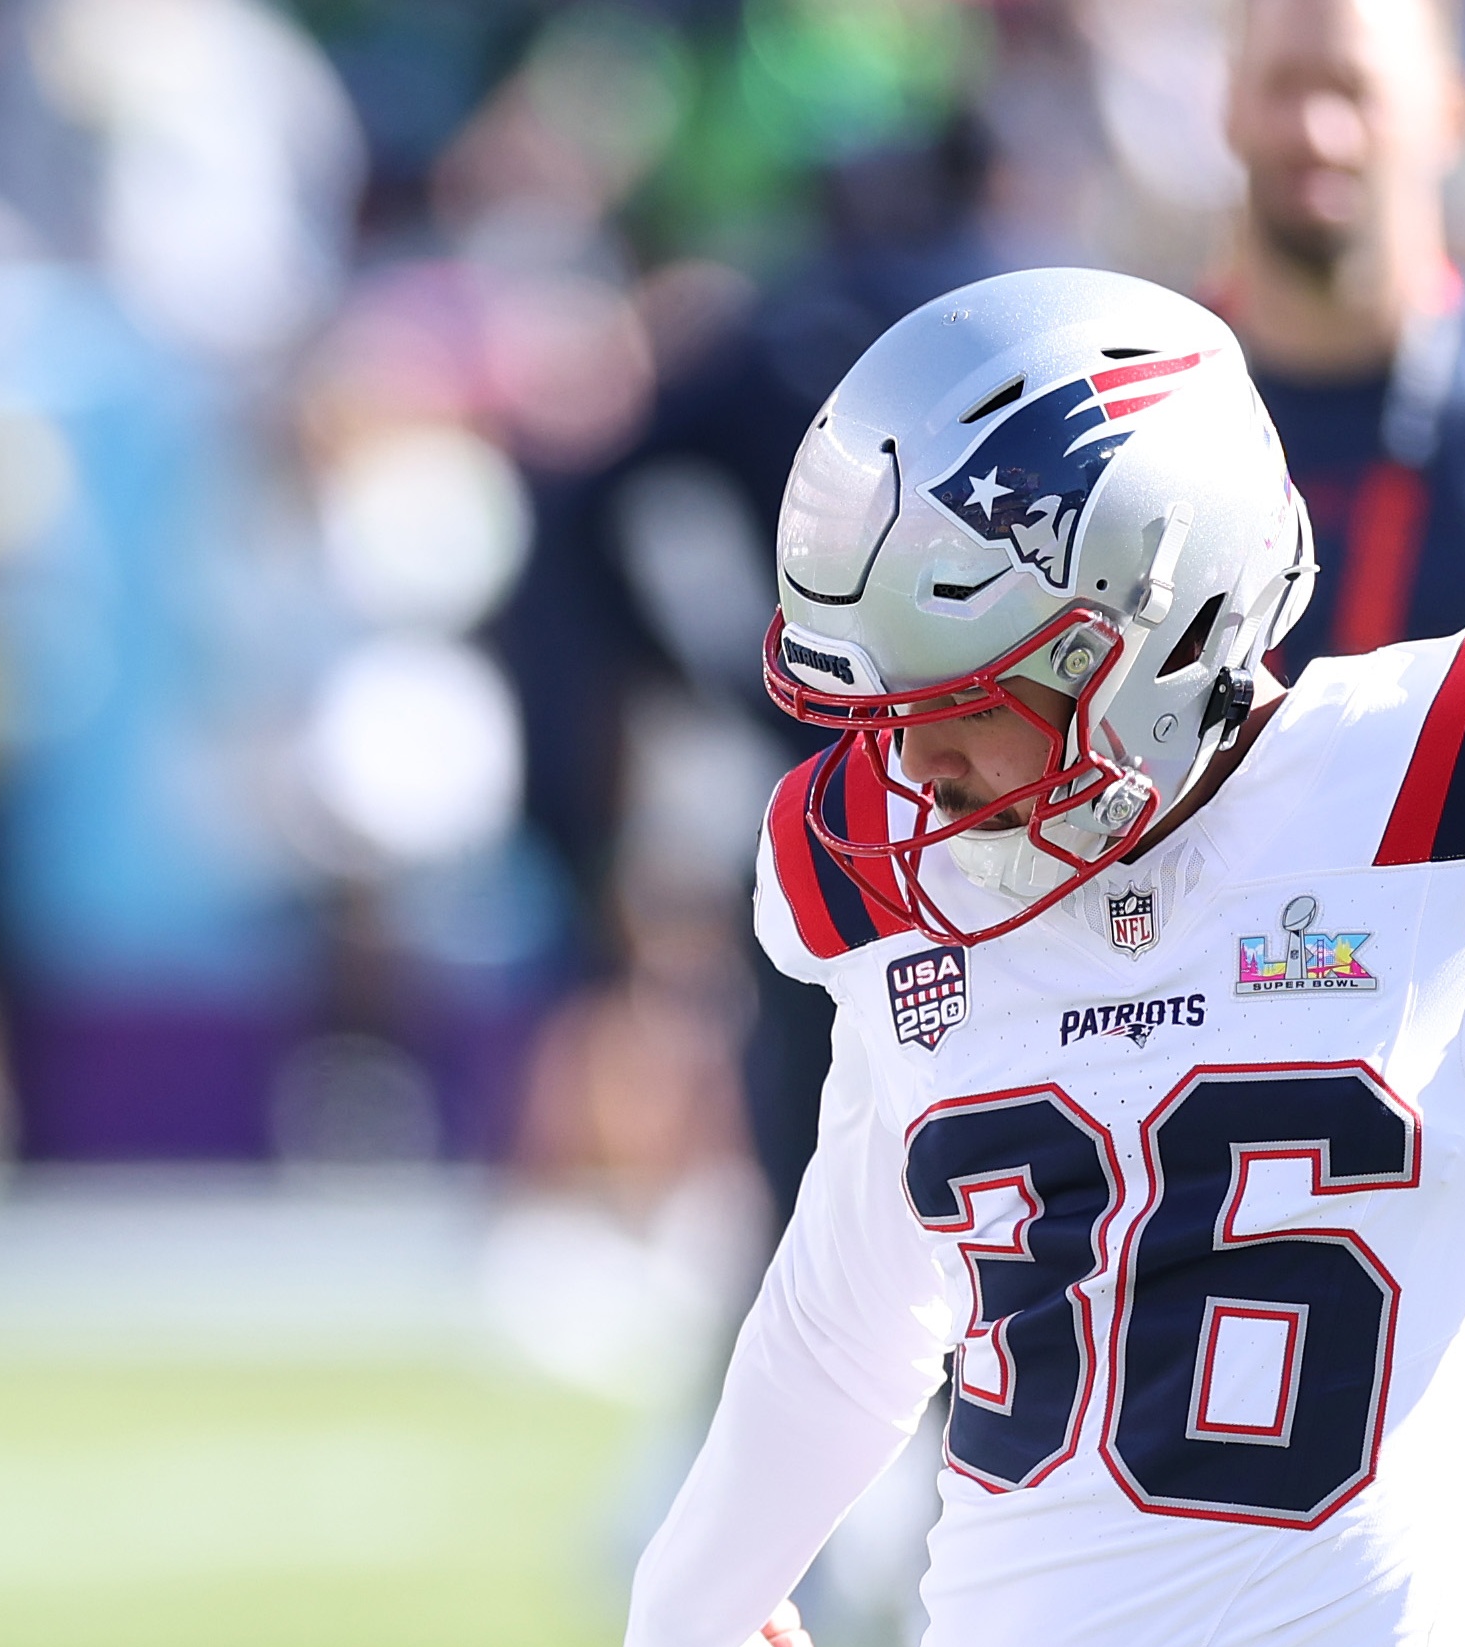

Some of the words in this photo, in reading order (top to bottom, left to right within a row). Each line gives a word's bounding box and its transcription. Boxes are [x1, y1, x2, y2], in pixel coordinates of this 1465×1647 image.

[1114, 915, 1150, 945] NFL
[893, 954, 961, 992] USA
[1253, 982, 1305, 991] SUPER
[1312, 980, 1359, 988] BOWL
[896, 995, 965, 1041] 250
[1060, 994, 1206, 1047] PATRIOTS
[902, 1059, 1422, 1531] 36
